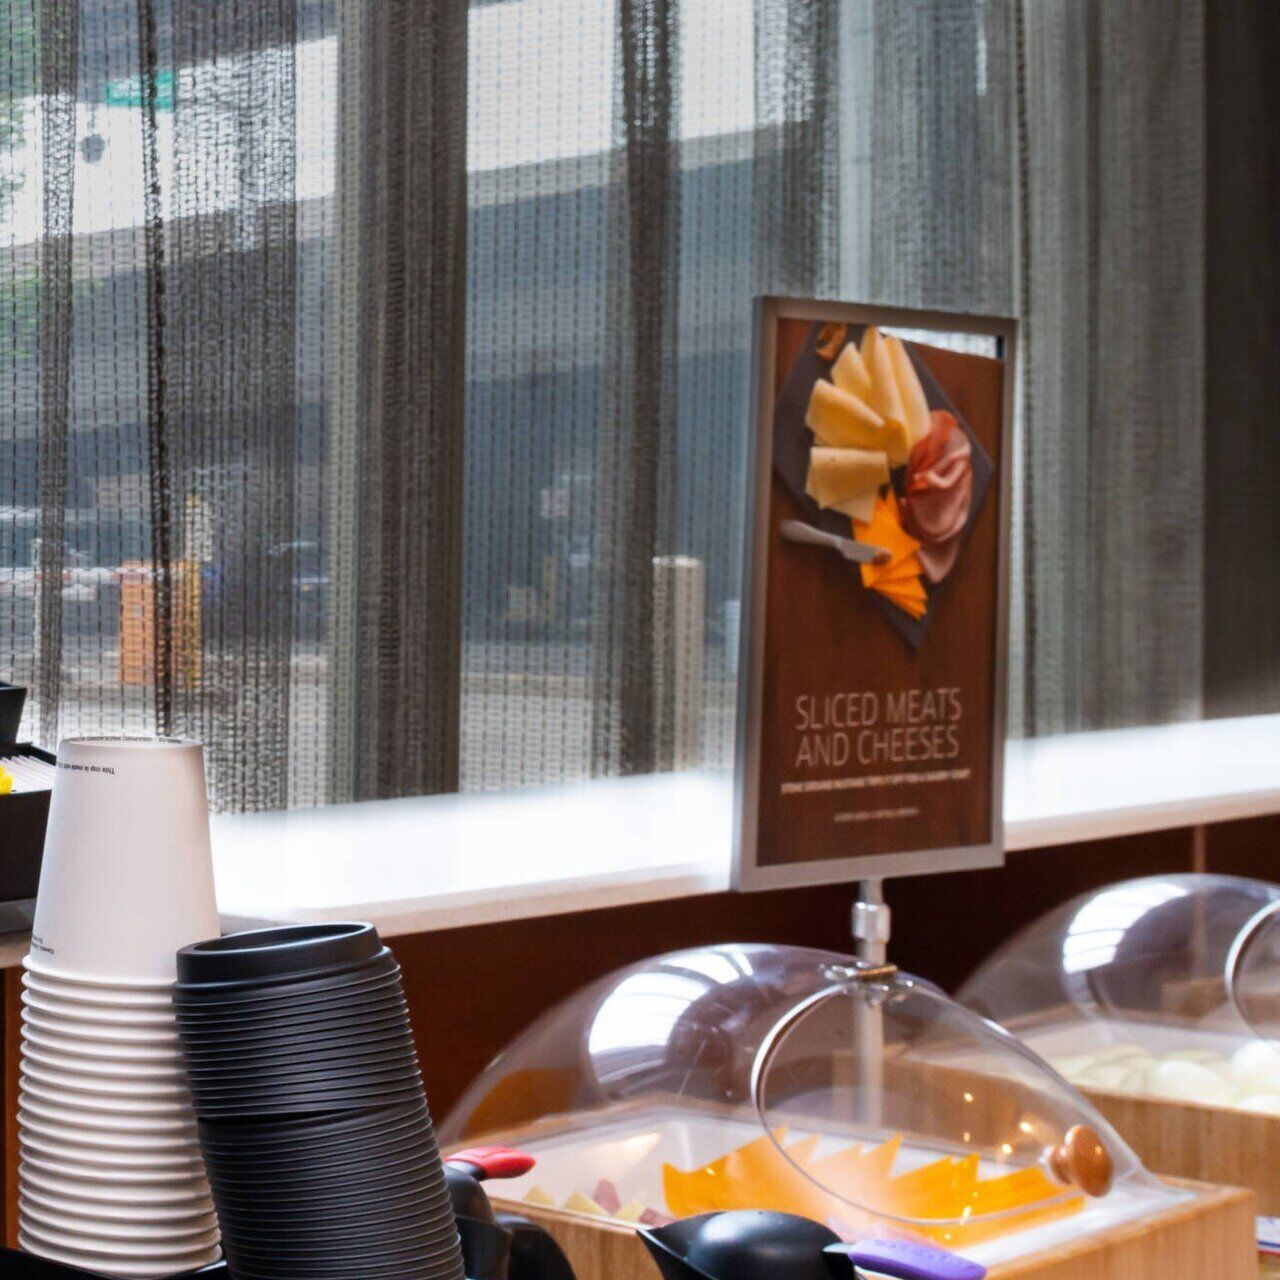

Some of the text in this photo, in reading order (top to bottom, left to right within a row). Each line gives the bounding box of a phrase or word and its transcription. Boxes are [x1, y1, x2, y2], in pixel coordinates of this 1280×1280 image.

[795, 687, 962, 731] SLICED MEATS
[796, 725, 960, 768] AND CHEESES
